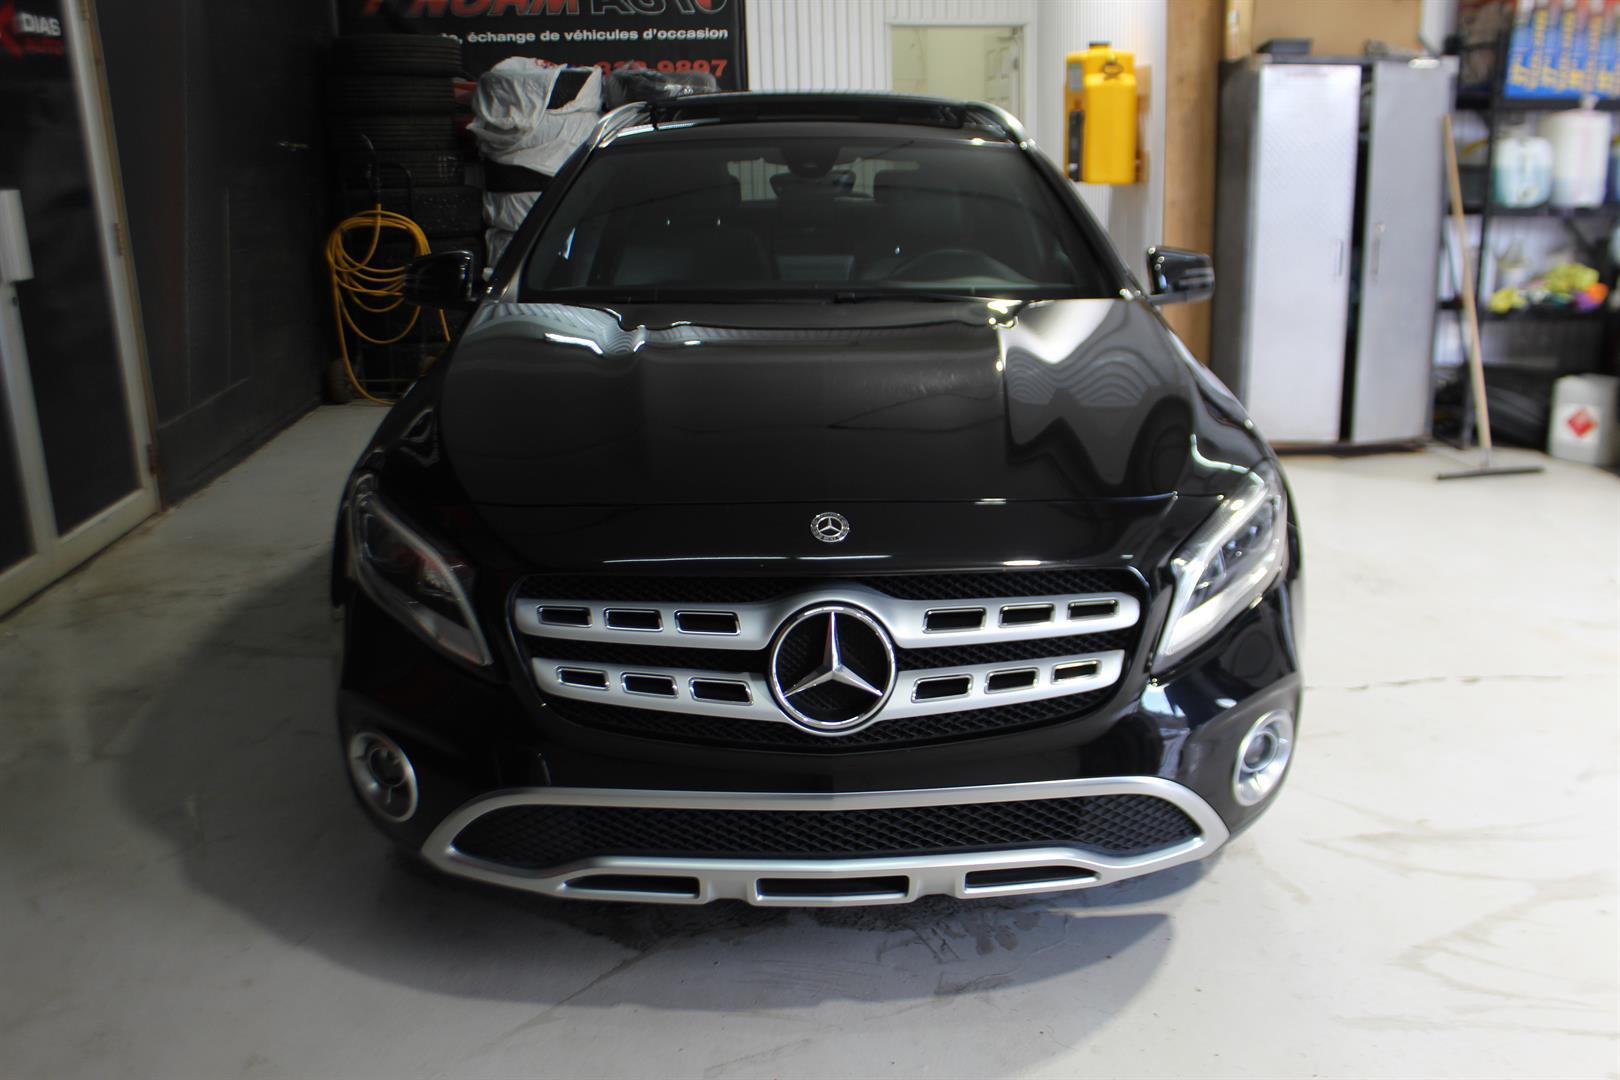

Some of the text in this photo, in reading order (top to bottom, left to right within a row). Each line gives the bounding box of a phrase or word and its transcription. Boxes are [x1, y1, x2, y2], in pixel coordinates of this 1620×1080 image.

[467, 31, 536, 44] échange
[540, 29, 560, 42] de
[564, 28, 639, 42] véhicules
[642, 27, 728, 40] d'occasion
